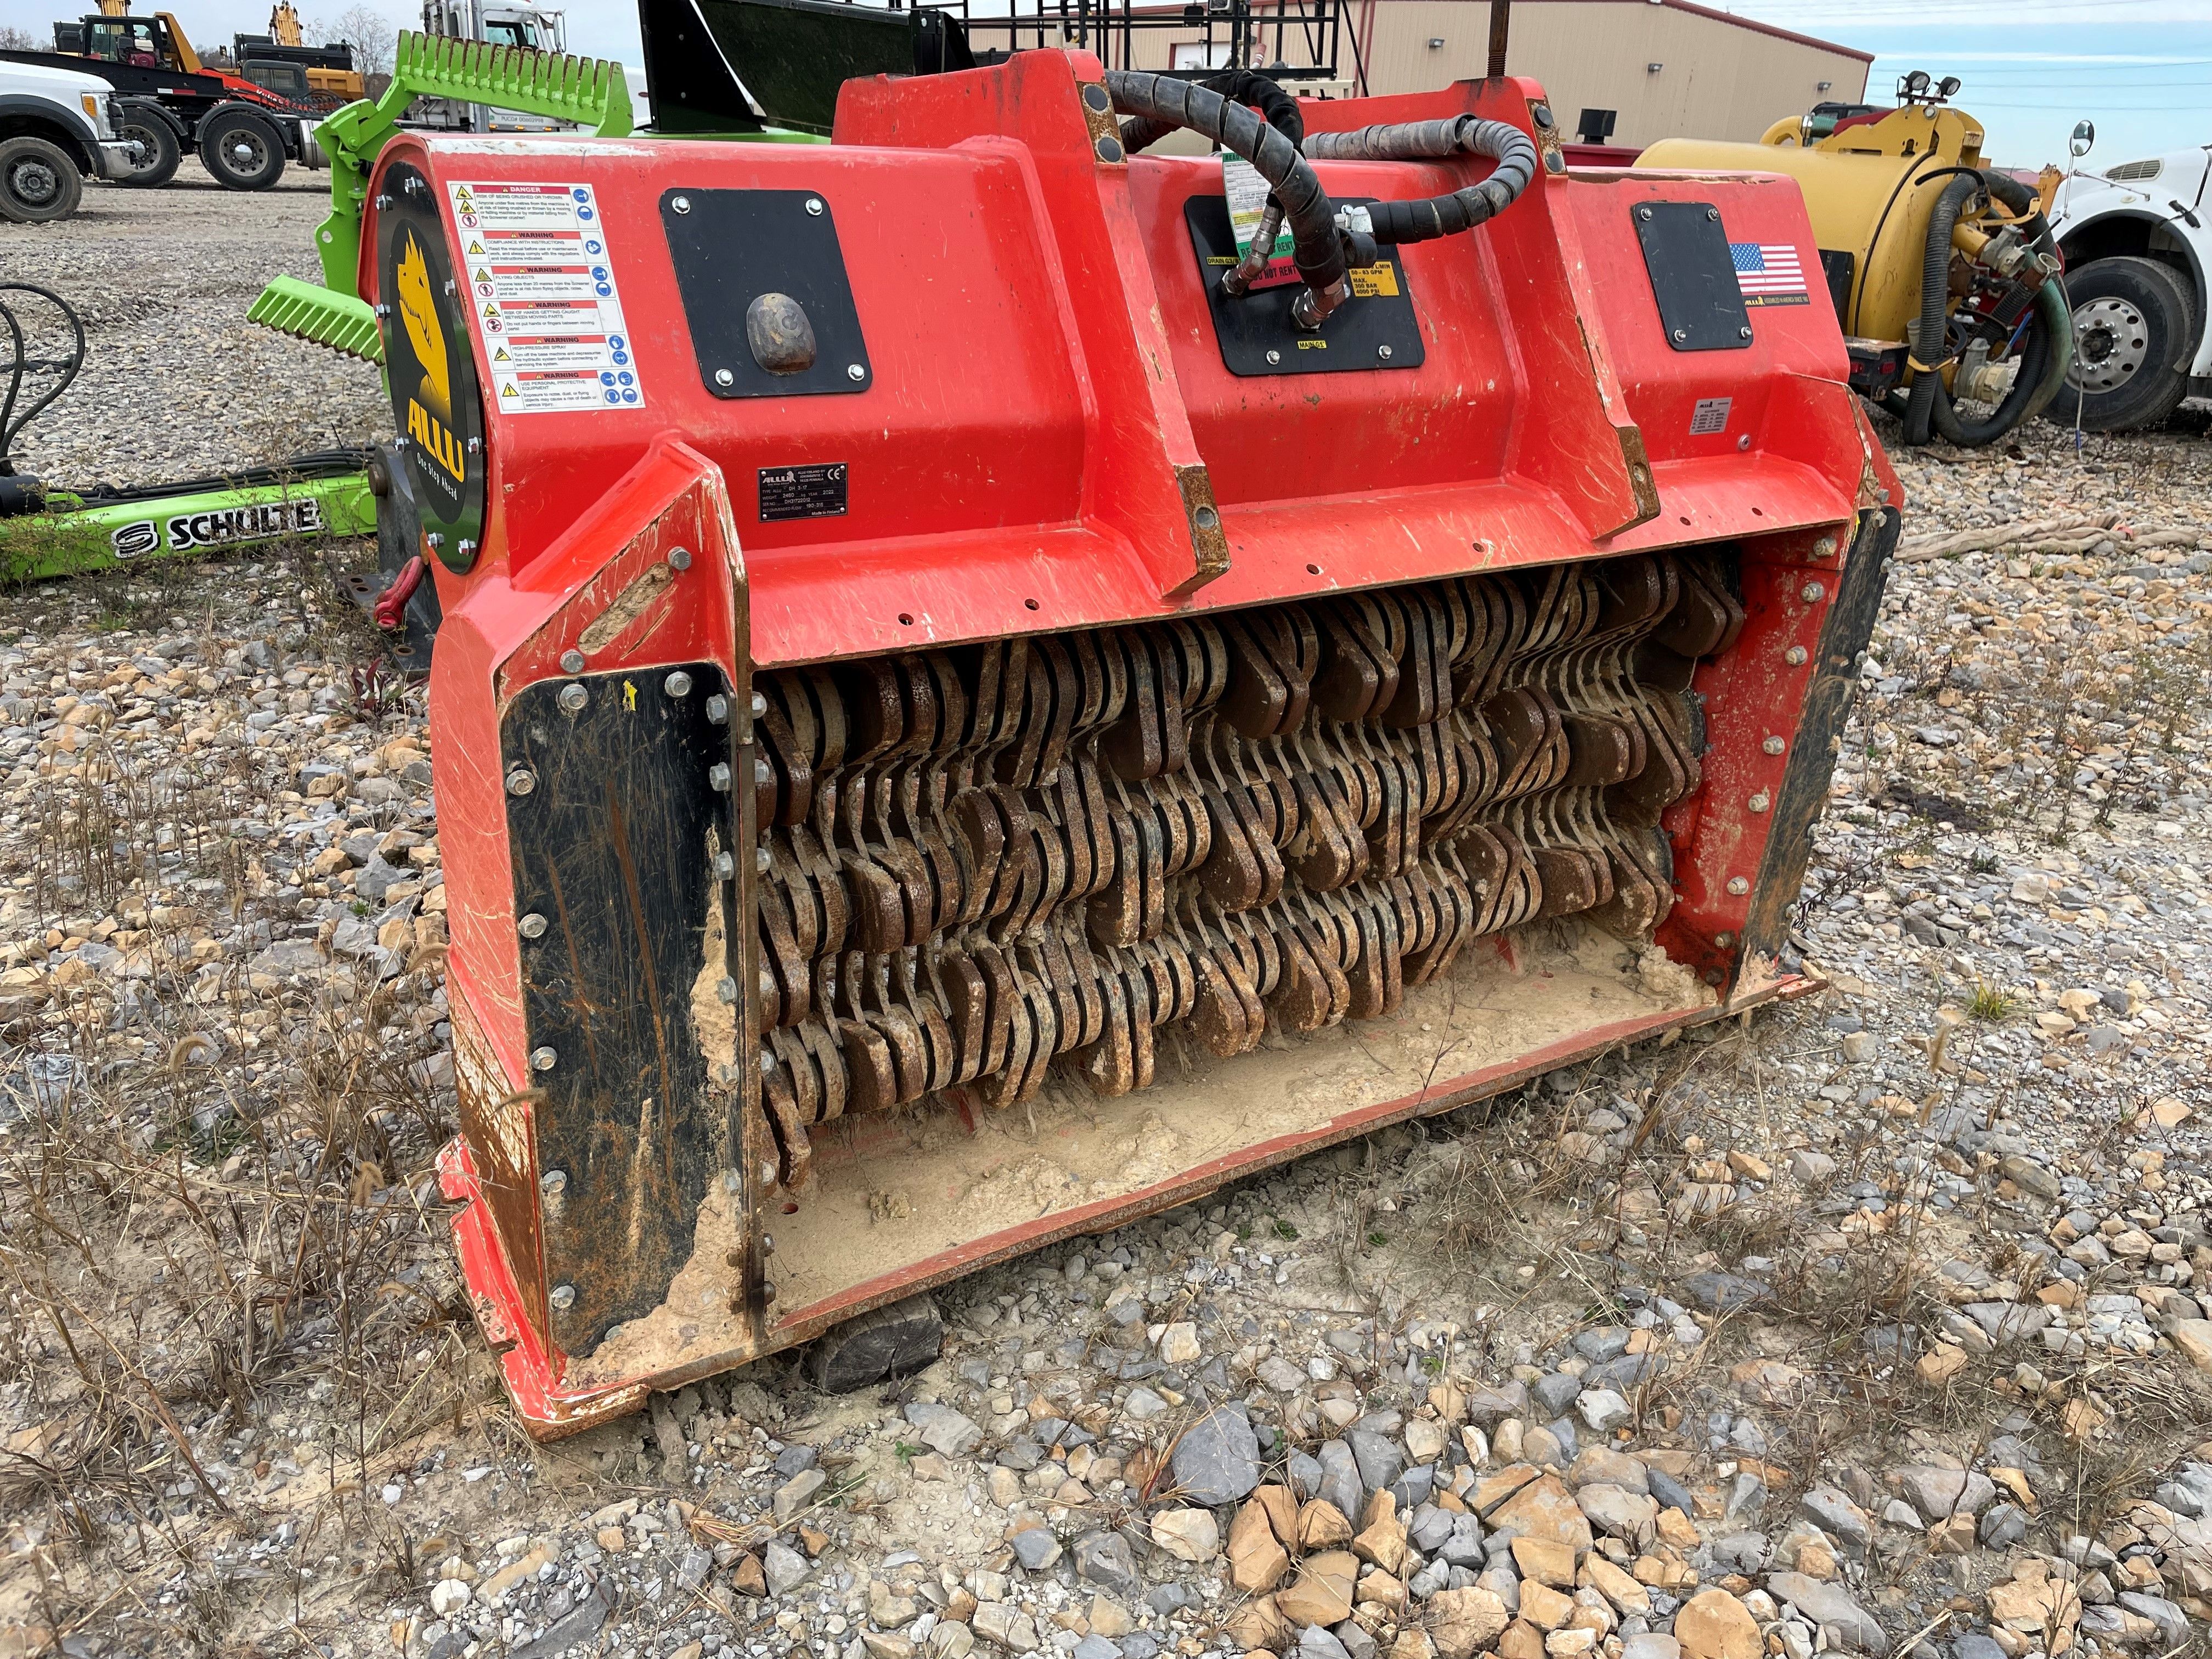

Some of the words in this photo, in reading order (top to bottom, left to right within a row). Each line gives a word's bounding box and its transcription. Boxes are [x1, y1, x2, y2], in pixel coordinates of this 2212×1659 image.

[1277, 241, 1294, 252] RENT
[1263, 268, 1277, 279] NOT
[1279, 265, 1295, 276] RENT
[408, 397, 465, 483] ALLU
[417, 452, 427, 470] One
[428, 462, 439, 486] Step
[442, 476, 458, 501] Ahead
[169, 497, 325, 549] SCHULTE
